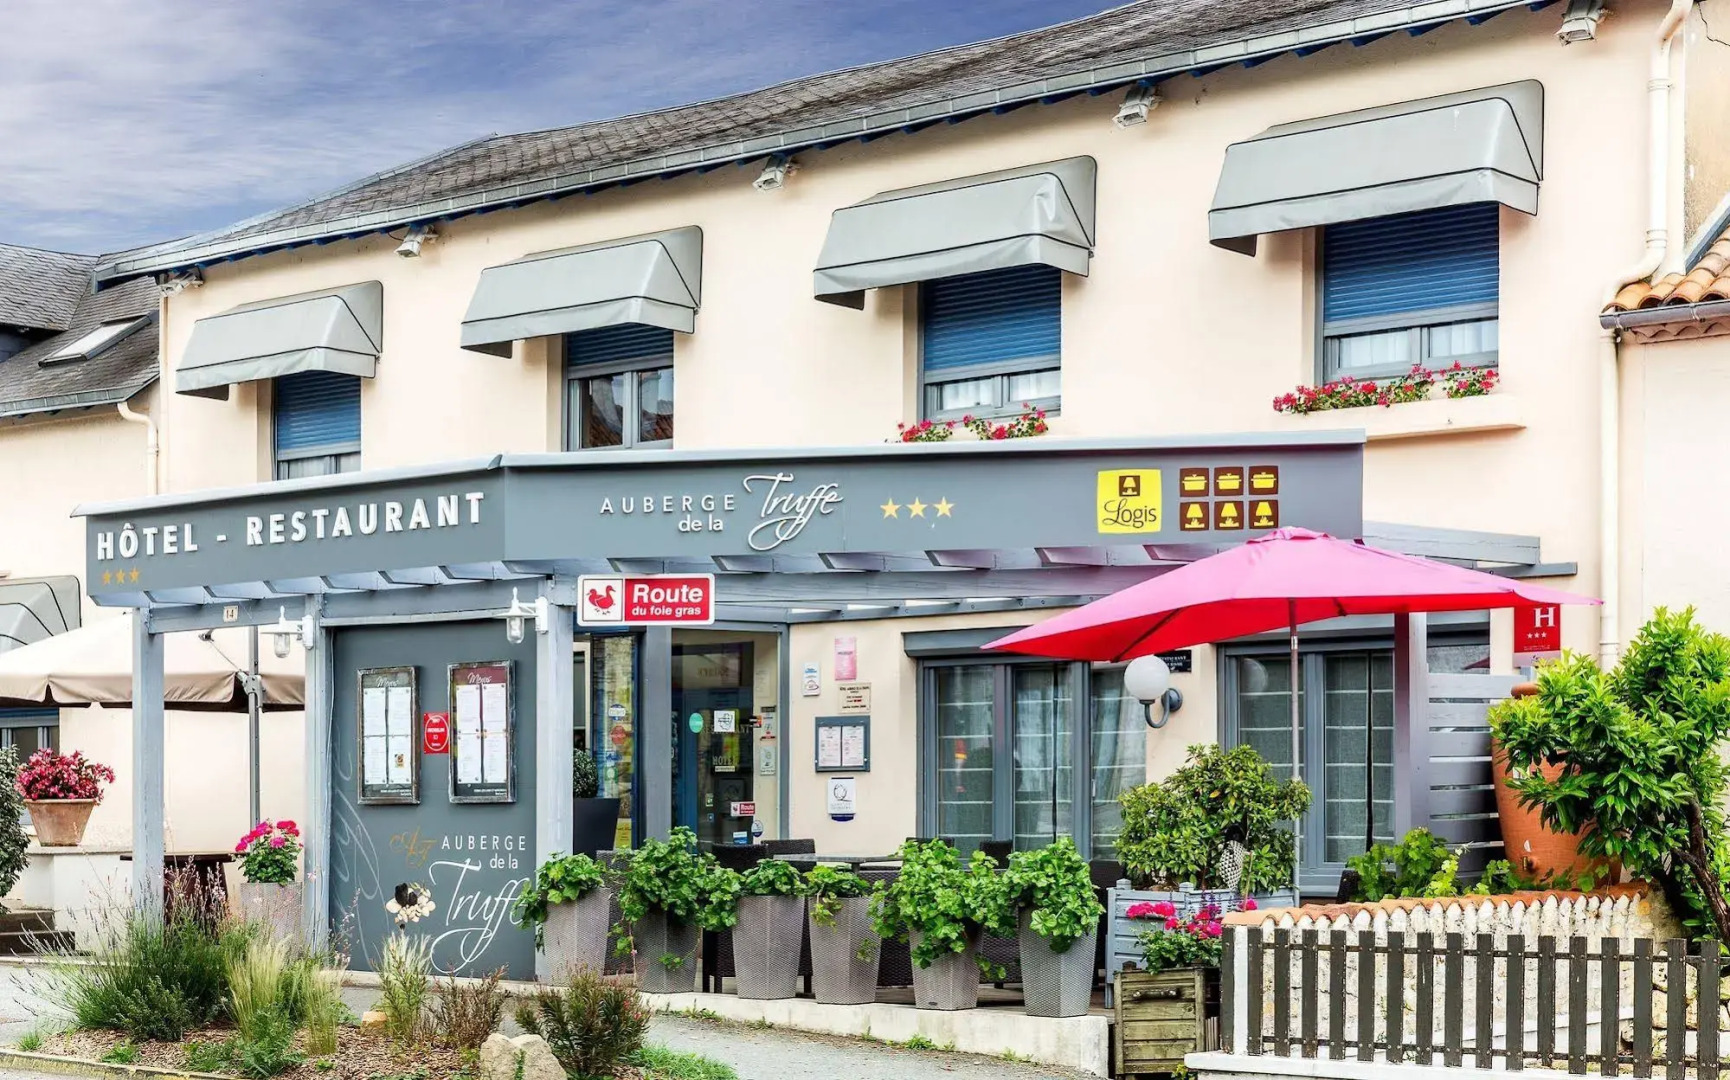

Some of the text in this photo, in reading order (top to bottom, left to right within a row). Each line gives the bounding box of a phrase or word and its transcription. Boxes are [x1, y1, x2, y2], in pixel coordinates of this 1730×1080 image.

[600, 493, 736, 515] AUBERGE
[742, 472, 844, 551] Truffe
[1101, 498, 1157, 529] Logis
[97, 522, 199, 561] HÔTEL
[246, 491, 485, 546] RESTAURANT
[678, 514, 724, 533] de la
[632, 583, 704, 604] Route
[226, 609, 234, 619] 14
[632, 605, 701, 618] du foie gras
[1533, 606, 1557, 629] H
[441, 835, 527, 851] AUBERGE
[490, 853, 519, 869] de la
